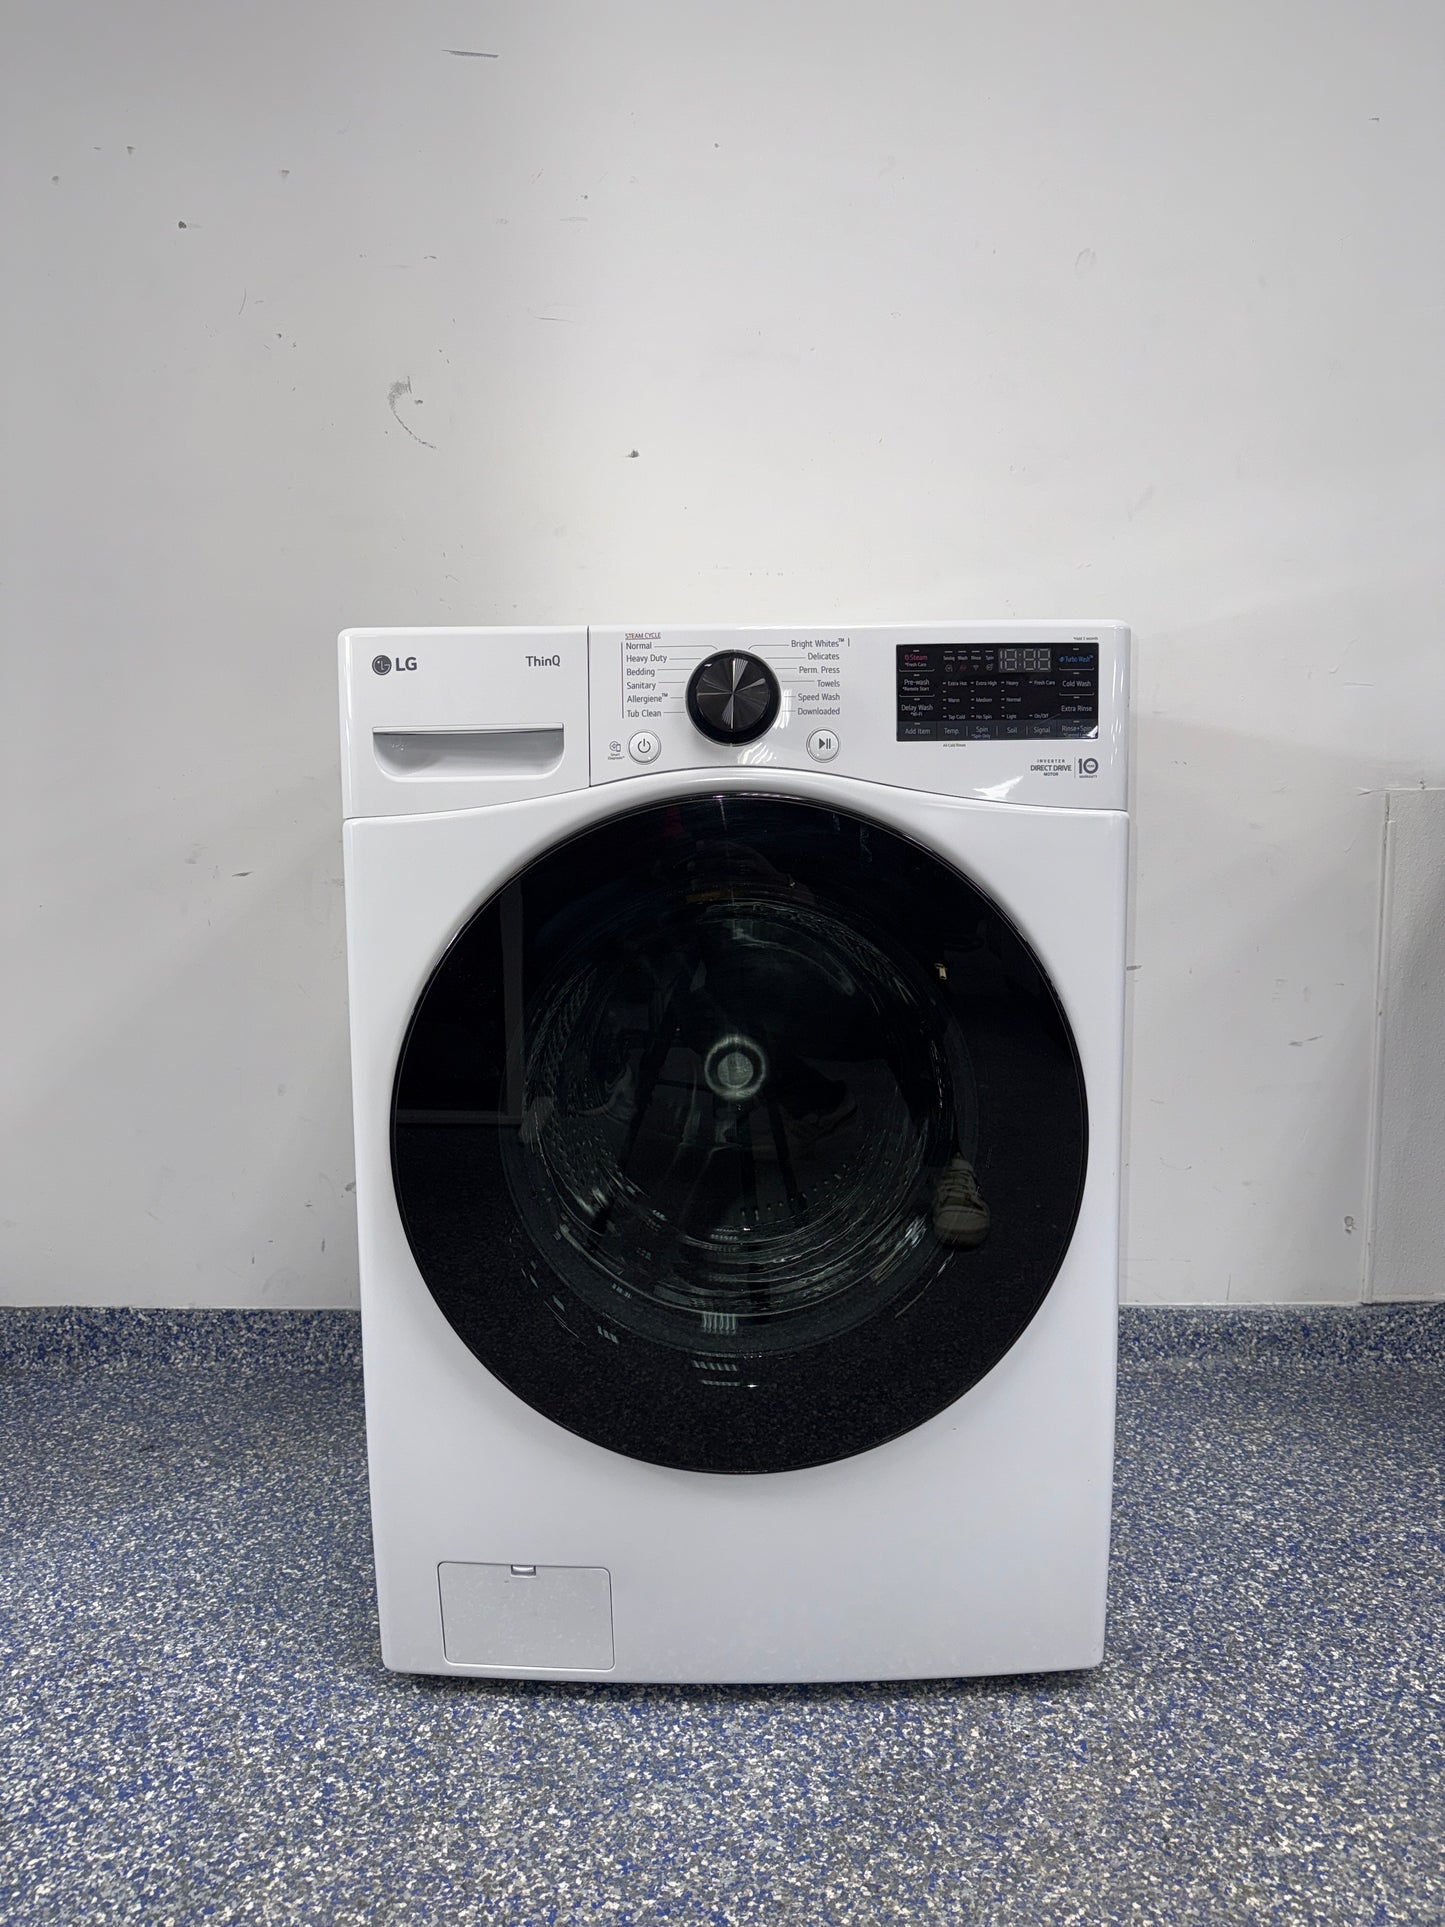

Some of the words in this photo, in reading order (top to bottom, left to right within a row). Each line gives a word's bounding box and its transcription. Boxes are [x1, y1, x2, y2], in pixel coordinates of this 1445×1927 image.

[791, 640, 812, 649] Bright
[525, 654, 560, 667] ThinQ
[626, 655, 648, 664] Heavy
[650, 654, 667, 663] Duty
[395, 657, 417, 671] LG
[627, 668, 655, 677] Bedding
[627, 682, 656, 690] Sanitary
[798, 693, 819, 702] Speed
[1078, 758, 1098, 774] 10
